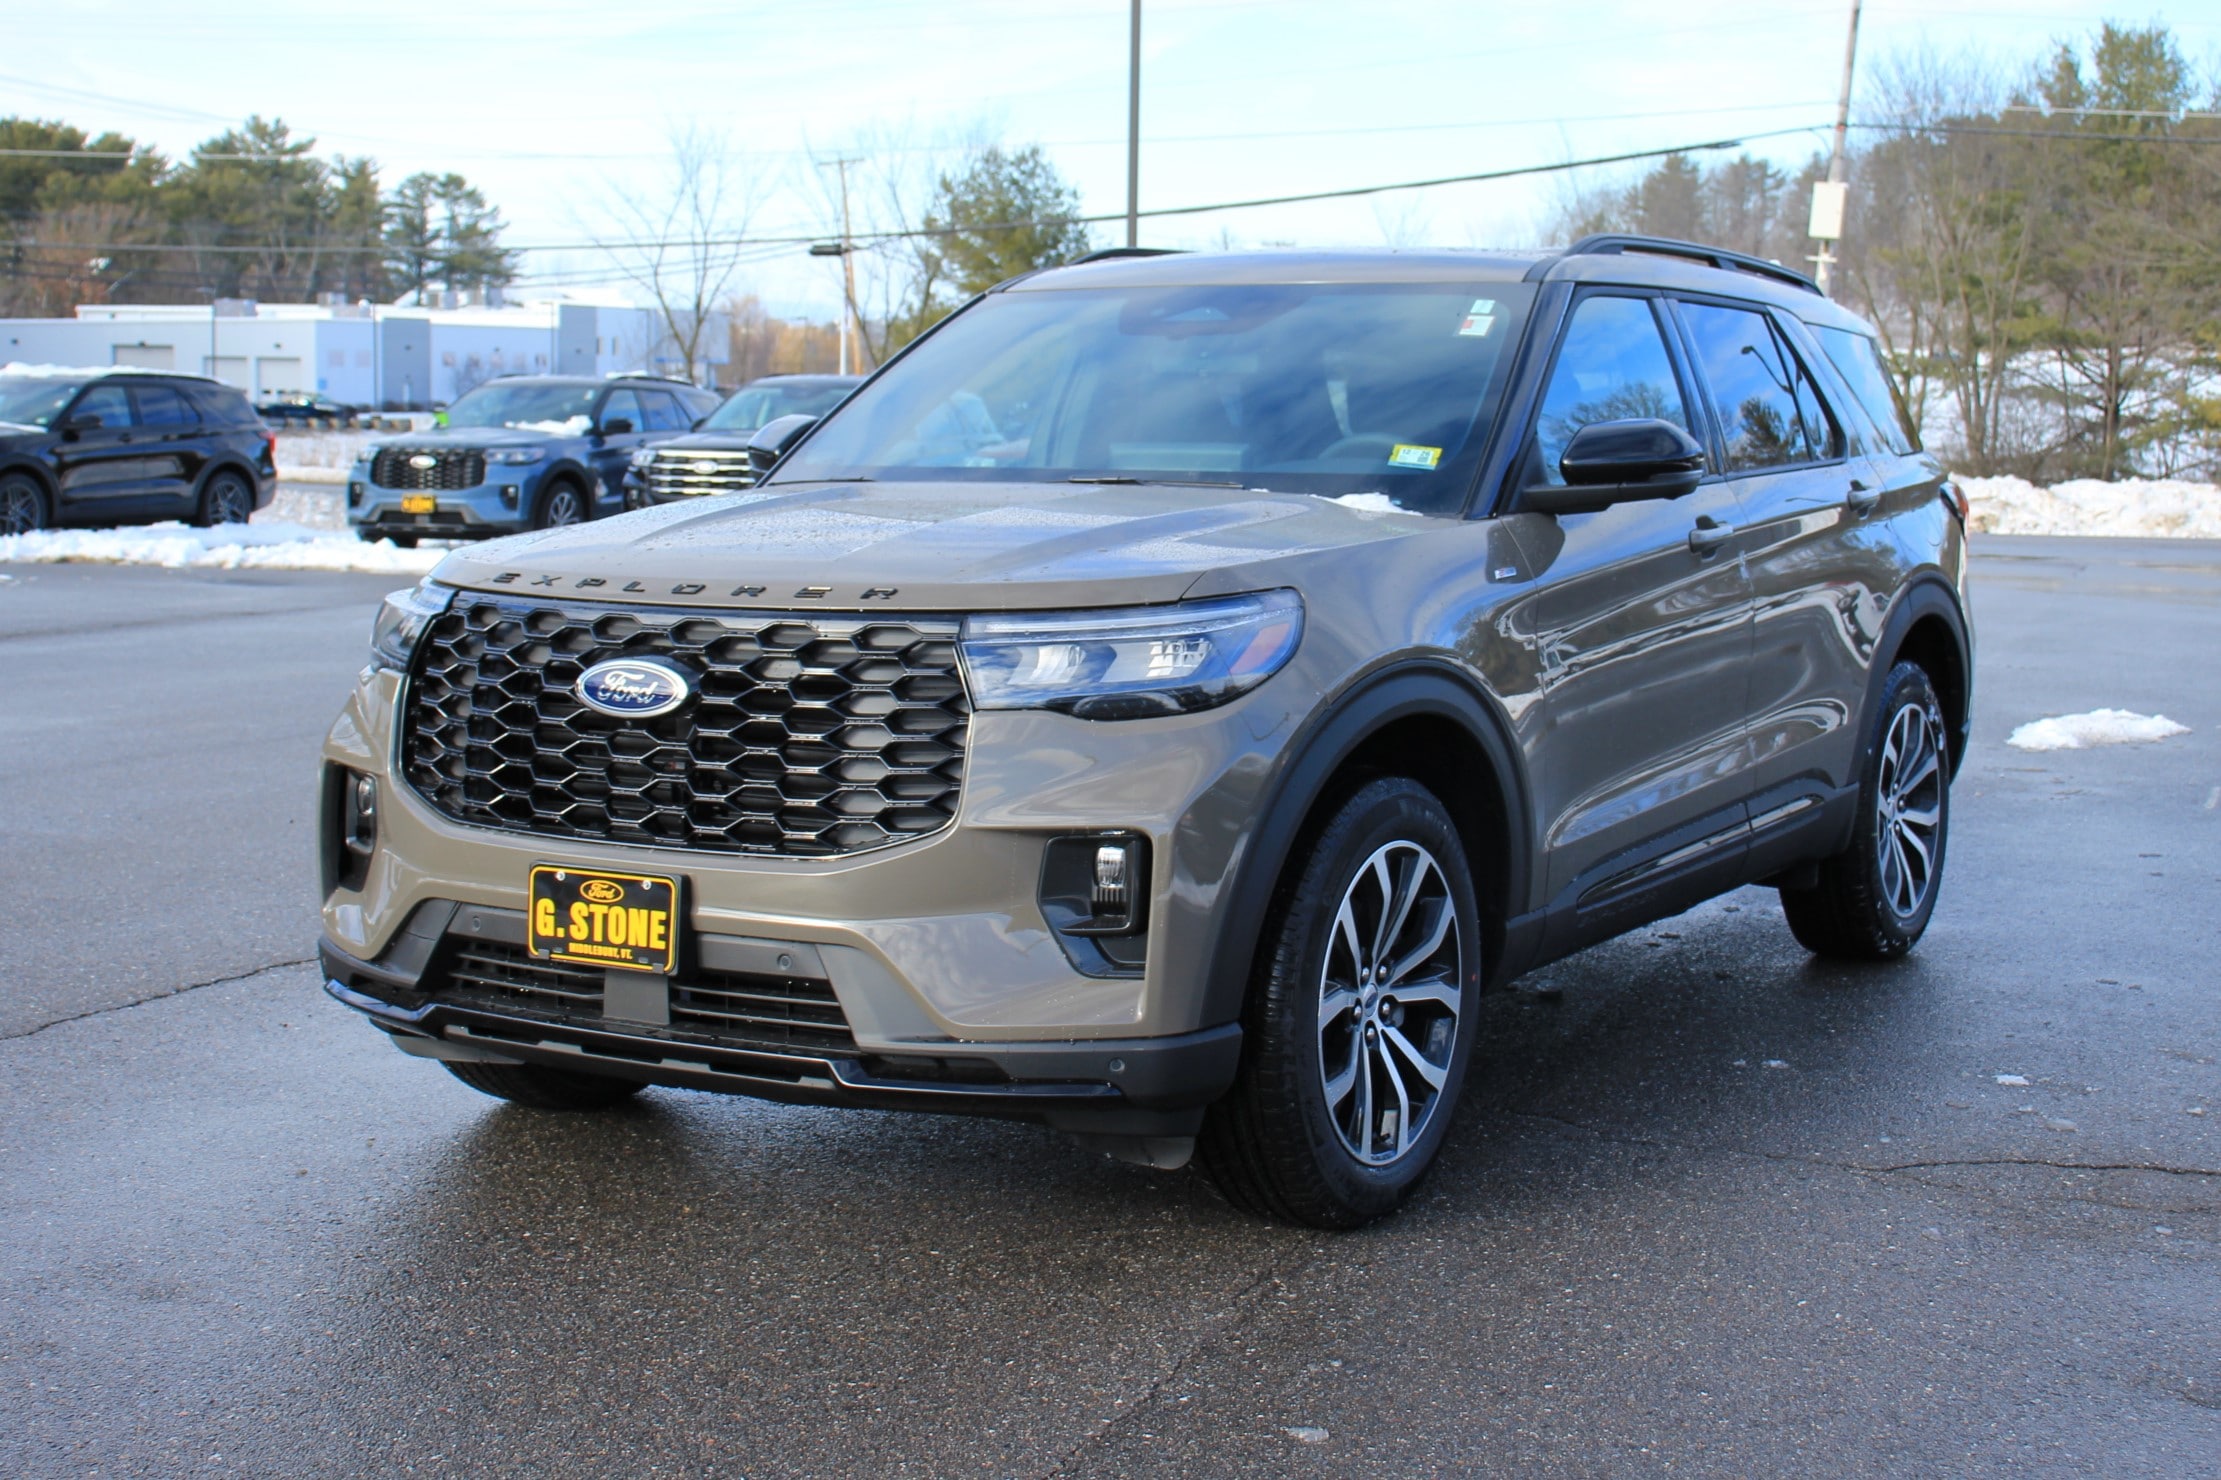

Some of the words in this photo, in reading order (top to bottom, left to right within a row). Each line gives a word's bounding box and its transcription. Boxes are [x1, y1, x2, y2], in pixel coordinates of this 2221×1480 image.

[493, 572, 898, 600] EXPLORER
[597, 670, 659, 704] Ford
[588, 882, 616, 900] Ford
[536, 898, 565, 938] G.
[569, 901, 667, 950] STONE
